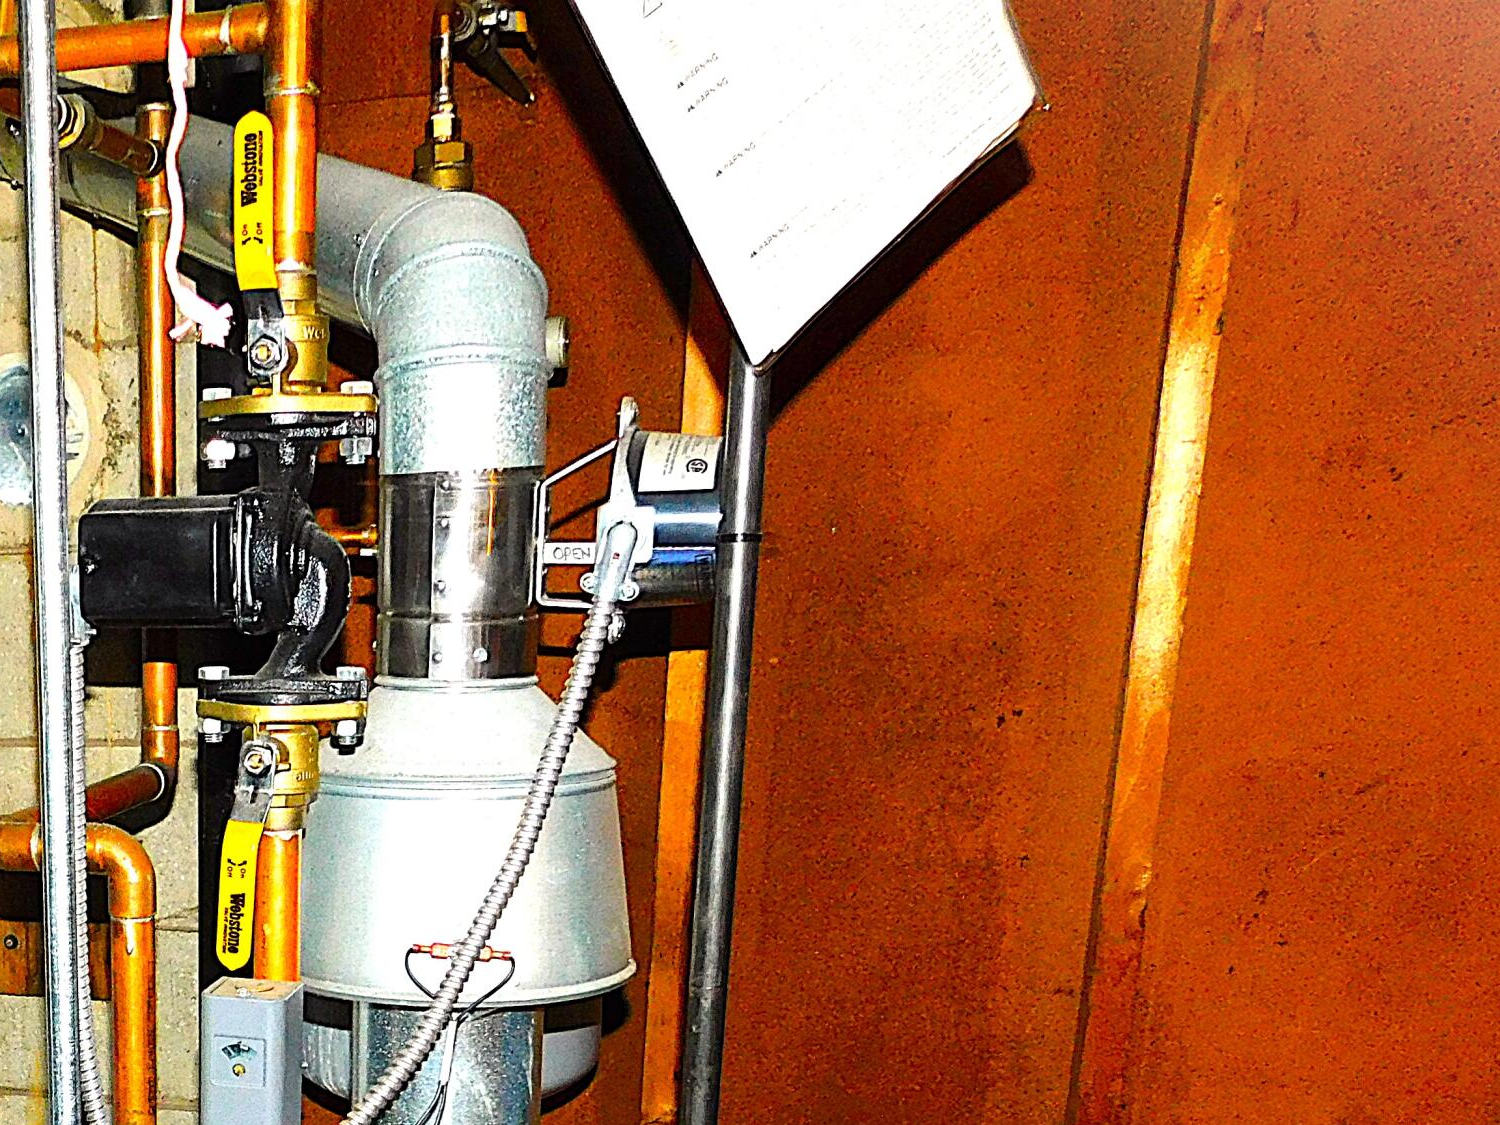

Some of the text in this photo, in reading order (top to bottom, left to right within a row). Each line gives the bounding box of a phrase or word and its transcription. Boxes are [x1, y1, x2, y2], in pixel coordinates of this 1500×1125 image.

[240, 132, 258, 208] Webstone
[553, 546, 591, 560] OPEN
[227, 893, 246, 954] Webstone
